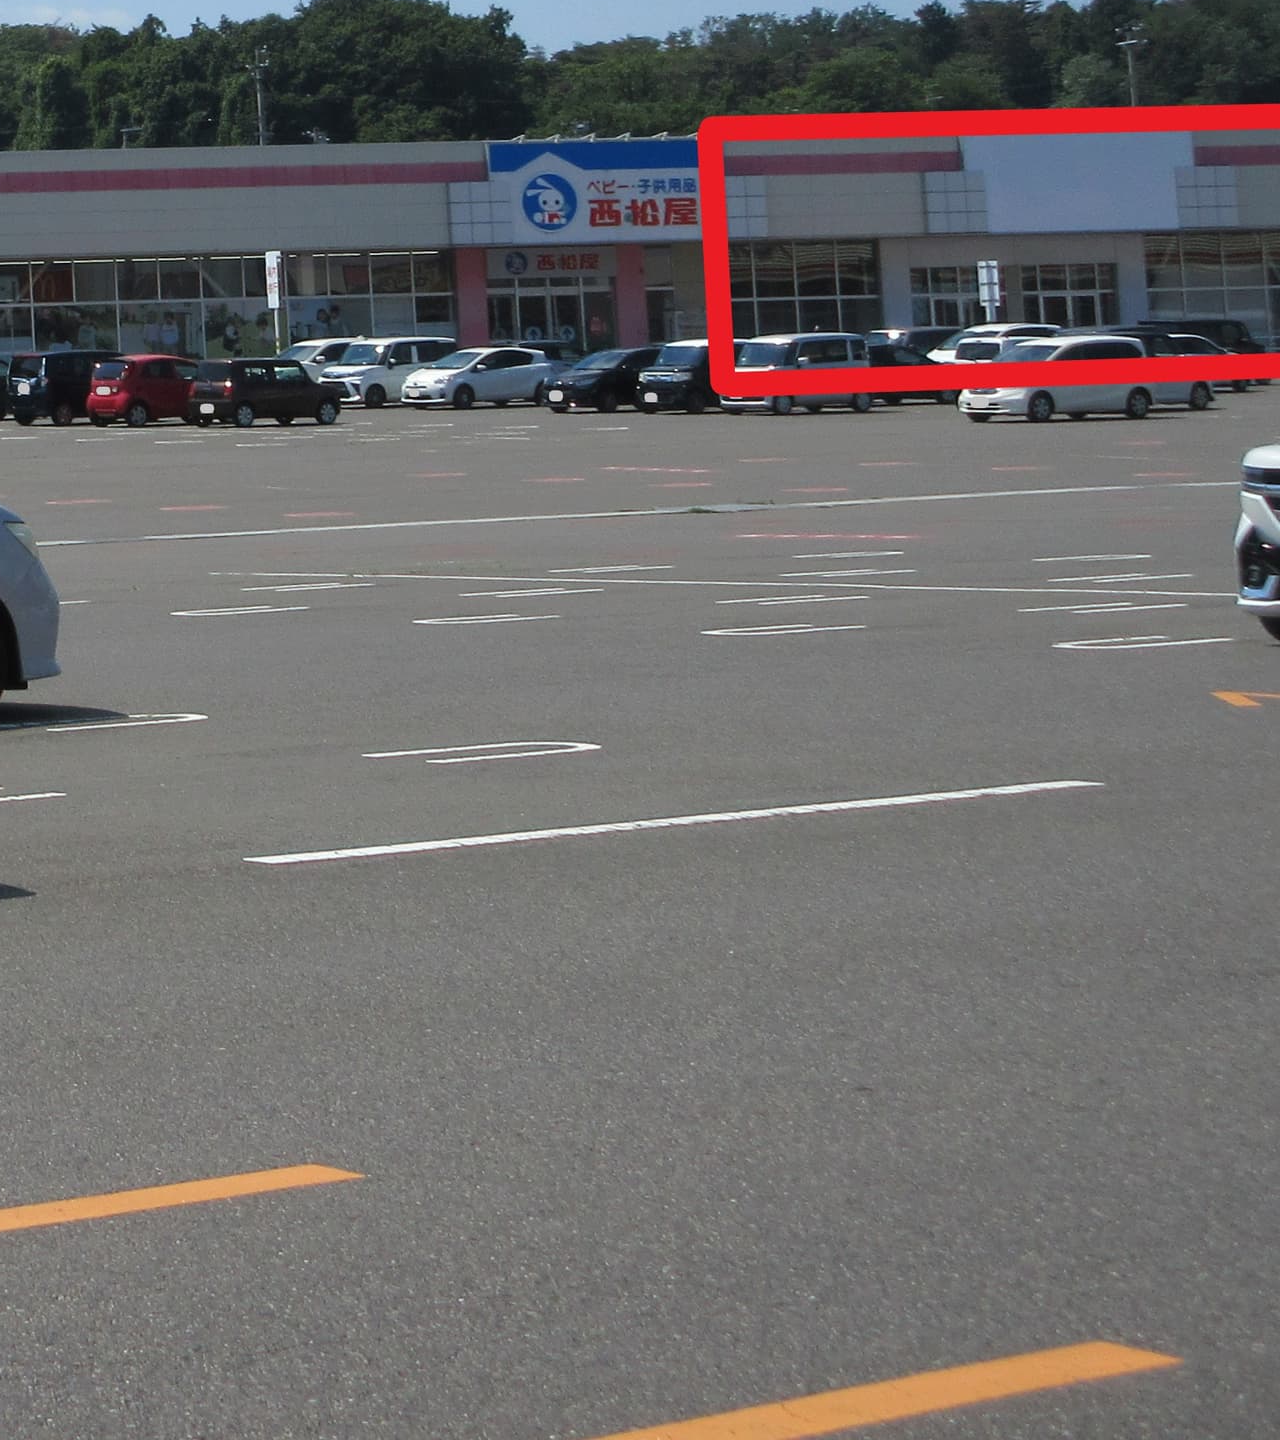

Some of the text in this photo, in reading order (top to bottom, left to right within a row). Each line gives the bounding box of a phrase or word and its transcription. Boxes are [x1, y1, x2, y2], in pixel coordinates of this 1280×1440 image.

[588, 197, 698, 227] 西松屋
[536, 253, 600, 271] 西松屋
